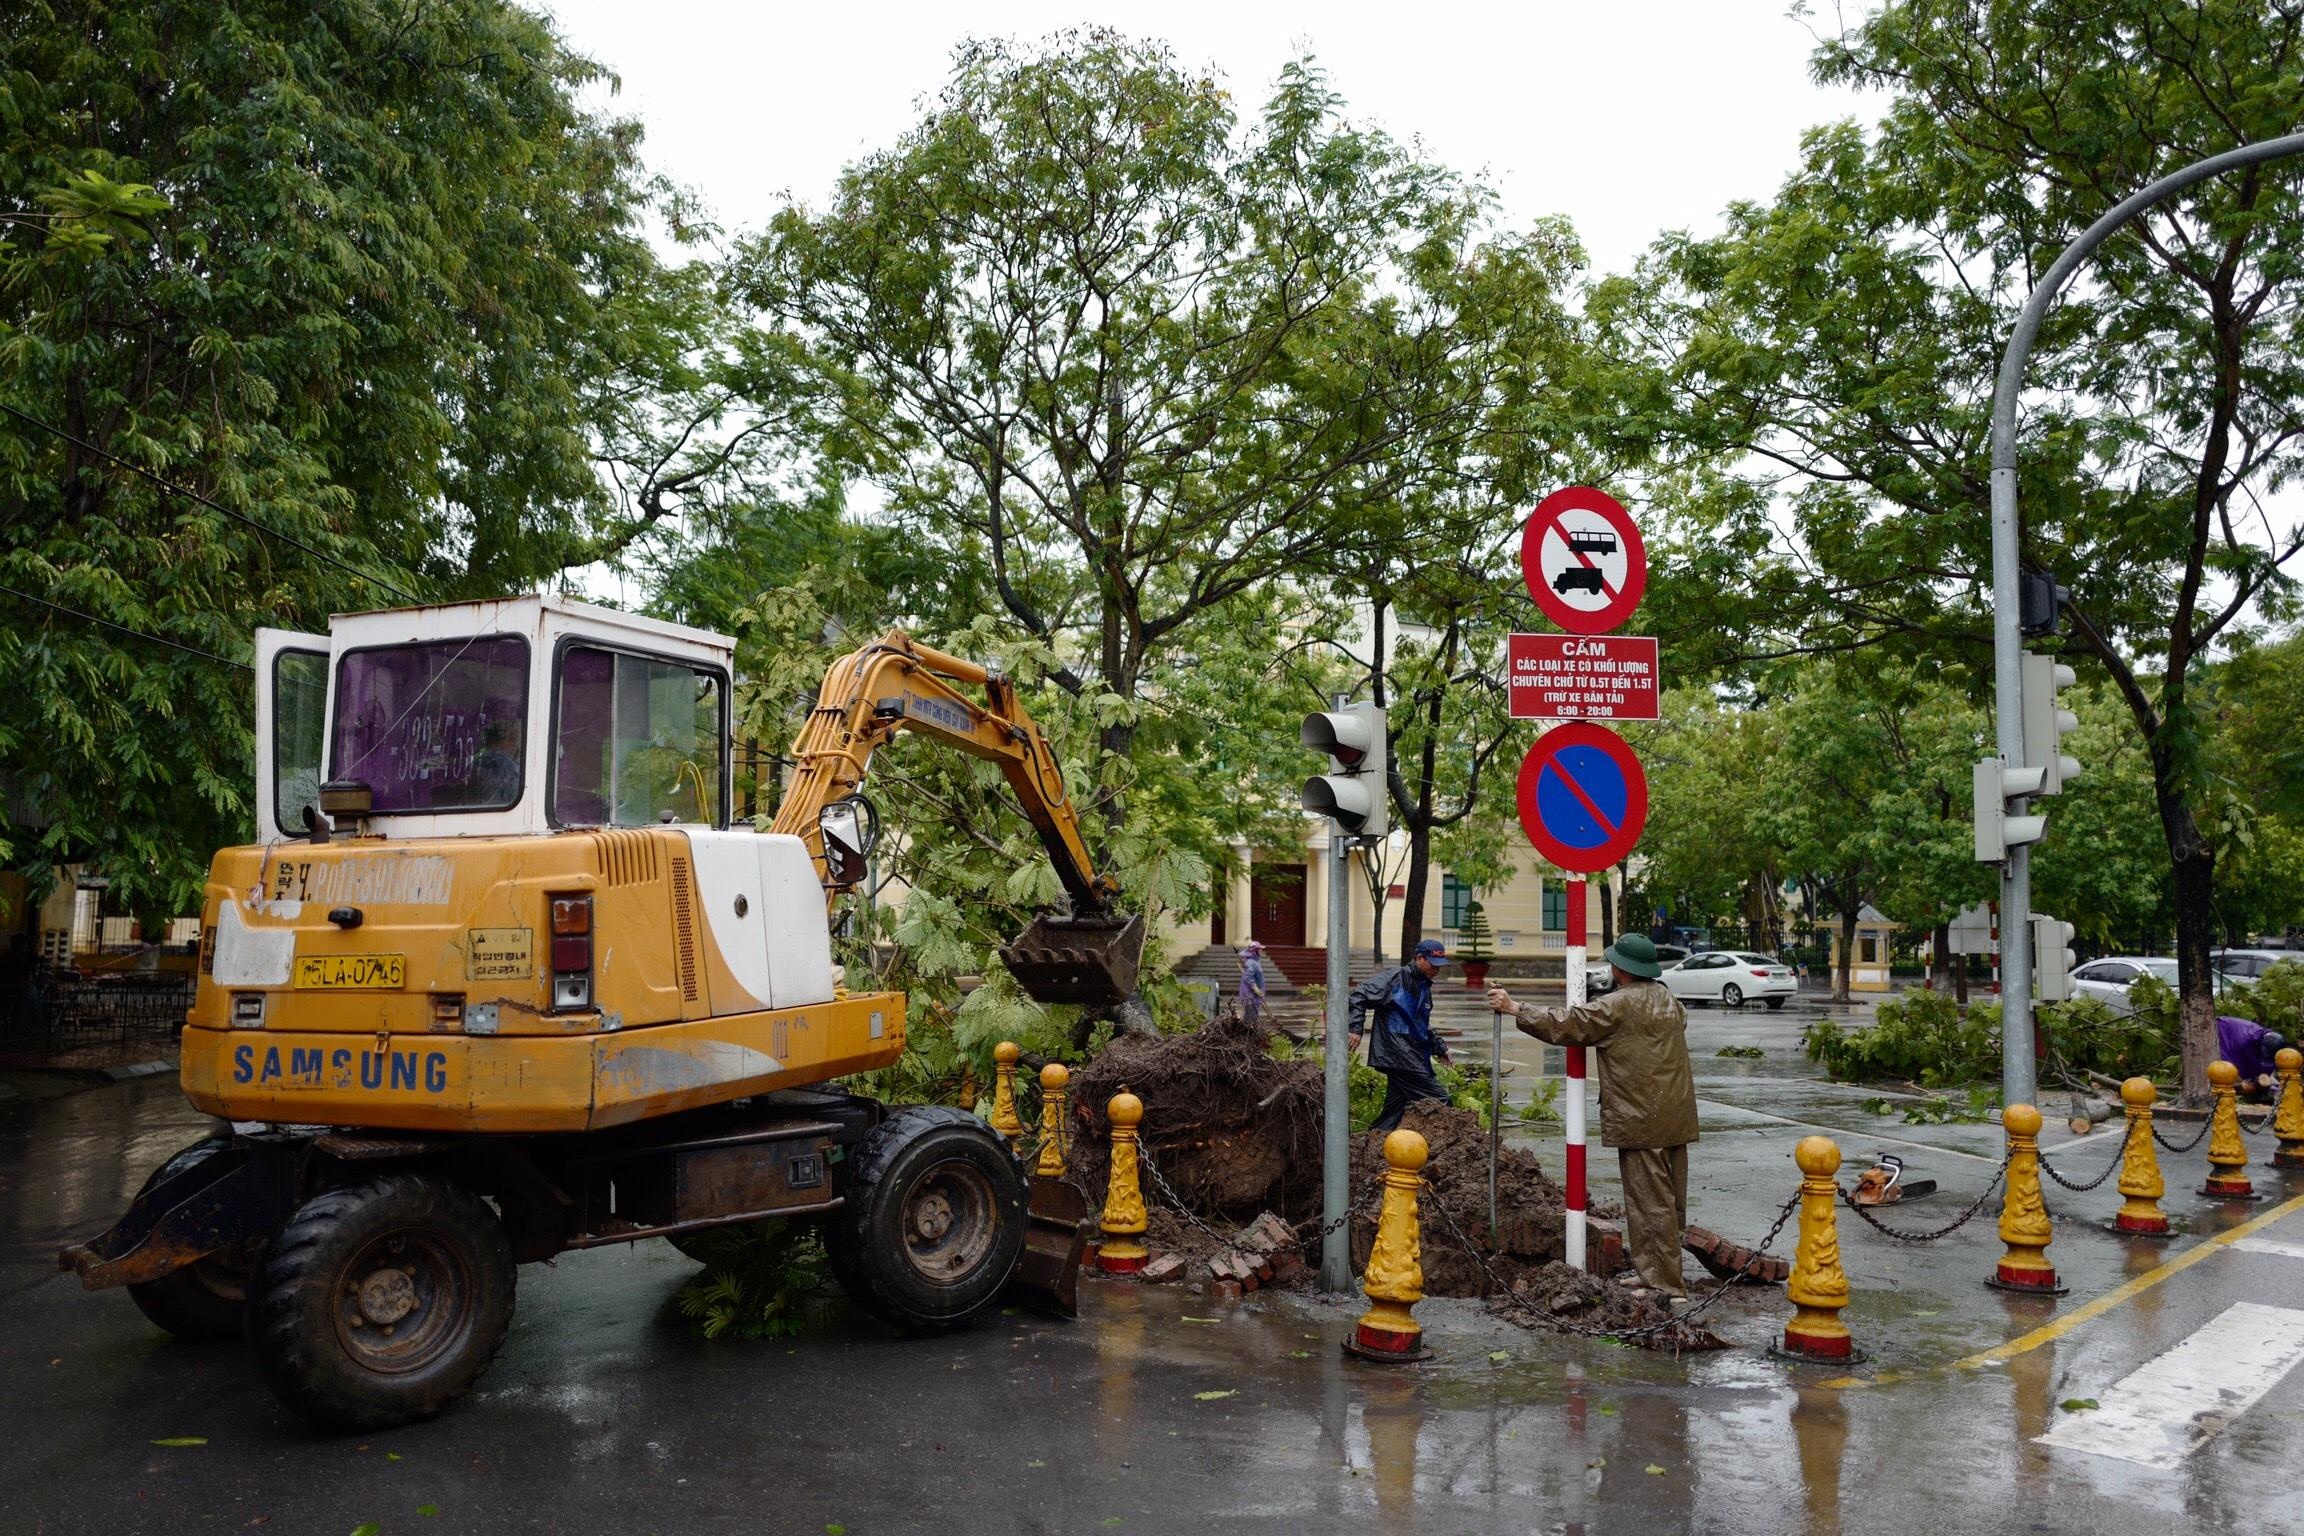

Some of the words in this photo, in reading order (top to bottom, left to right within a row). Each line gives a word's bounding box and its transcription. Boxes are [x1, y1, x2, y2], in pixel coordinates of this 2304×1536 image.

[1517, 657, 1537, 671] CÁC
[1539, 659, 1560, 673] LOẠI
[1564, 660, 1576, 671] XE
[1578, 658, 1591, 672] CÓ
[1594, 657, 1616, 673] KHỐI
[1618, 661, 1649, 675] LƯỢNG
[1512, 673, 1551, 687] CHUYÊN
[1553, 675, 1574, 688] CHỞ
[1575, 674, 1588, 688] TỪ
[1590, 678, 1610, 689] 0.5T
[1611, 674, 1631, 689] ĐẾN
[1633, 678, 1652, 689] 1.5T
[1544, 690, 1567, 703] (TRỪ
[1569, 692, 1581, 702] XE
[1605, 689, 1624, 704] TẢI)
[1557, 705, 1578, 716] 6:00
[1587, 706, 1613, 716] 20:00
[233, 1044, 447, 1093] SAMSUNG
